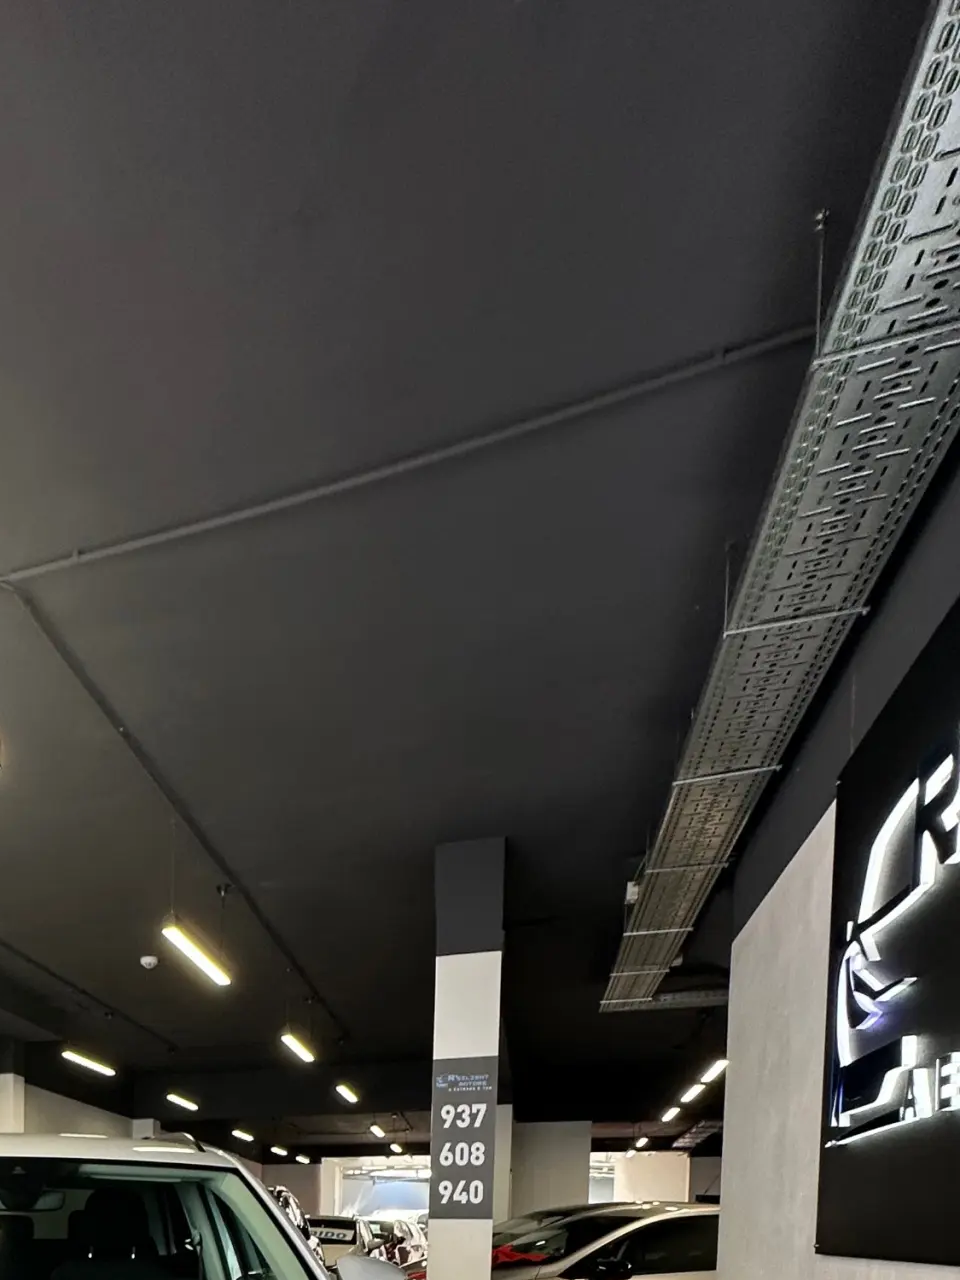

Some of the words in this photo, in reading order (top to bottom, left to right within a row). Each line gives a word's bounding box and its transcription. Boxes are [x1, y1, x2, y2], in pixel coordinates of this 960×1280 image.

[440, 1103, 487, 1129] 937
[439, 1141, 486, 1167] 608
[438, 1179, 484, 1205] 940
